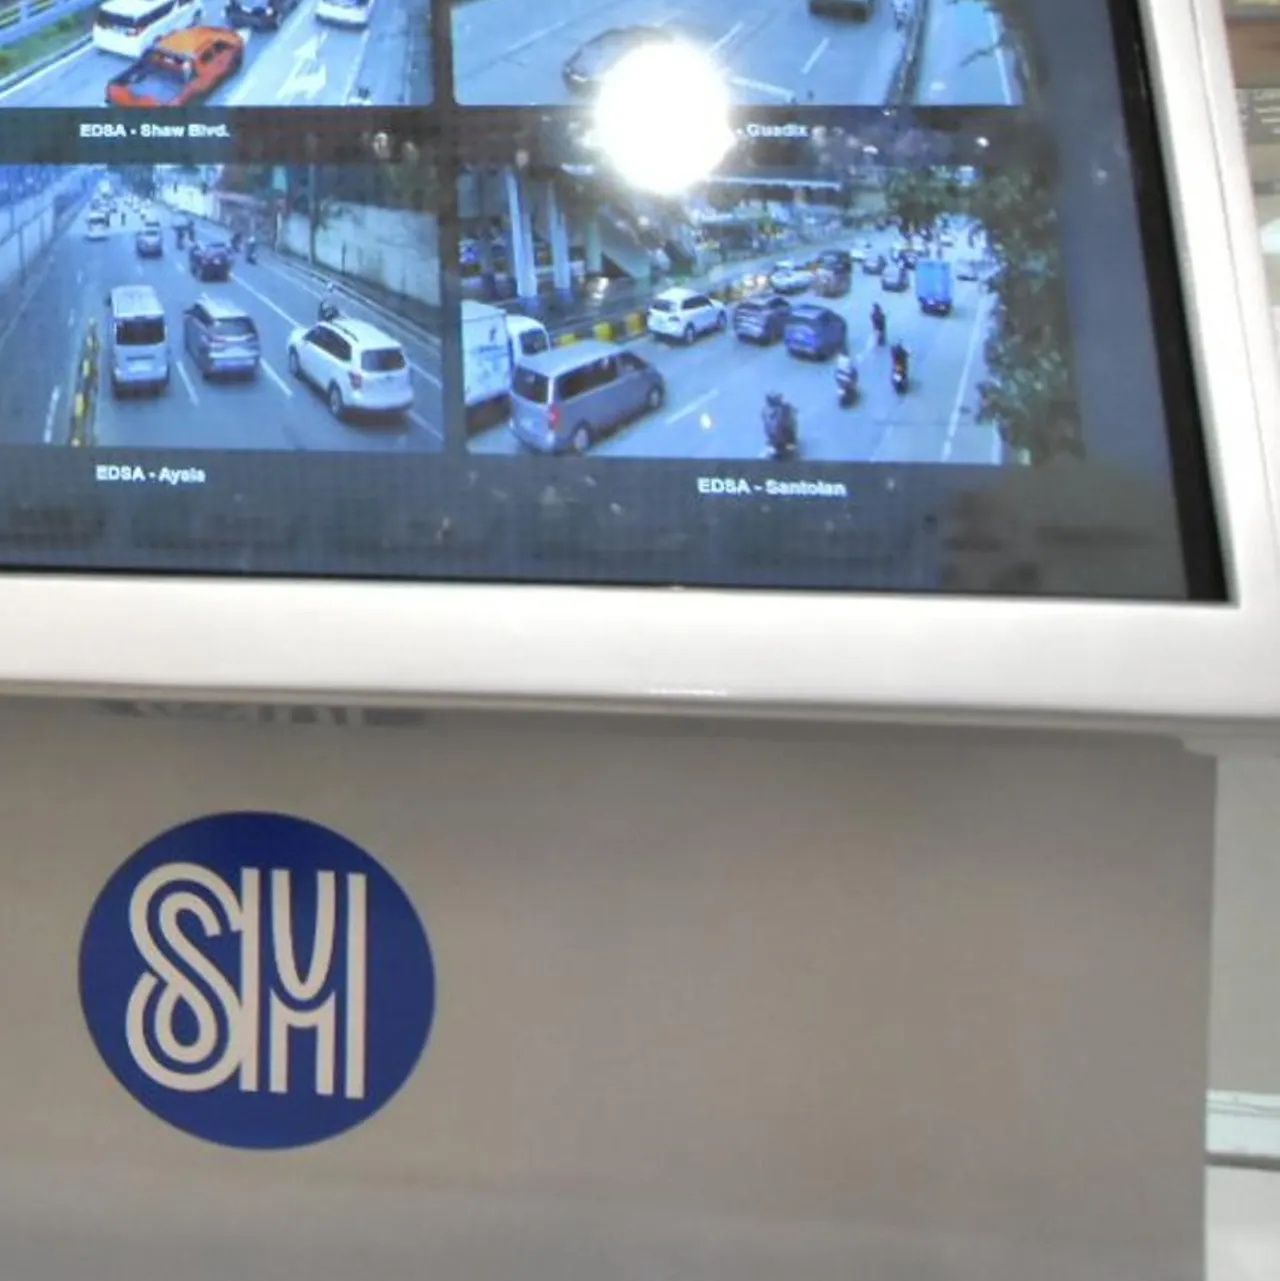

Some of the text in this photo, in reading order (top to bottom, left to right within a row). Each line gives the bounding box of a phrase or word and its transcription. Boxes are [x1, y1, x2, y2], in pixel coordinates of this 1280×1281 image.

[79, 123, 127, 138] EDSA
[140, 123, 185, 138] Shaw
[96, 465, 146, 481] EDSA
[158, 466, 206, 485] Ayala
[697, 477, 752, 494] EDSA
[765, 479, 847, 497] Santolan
[125, 861, 367, 1099] SM
